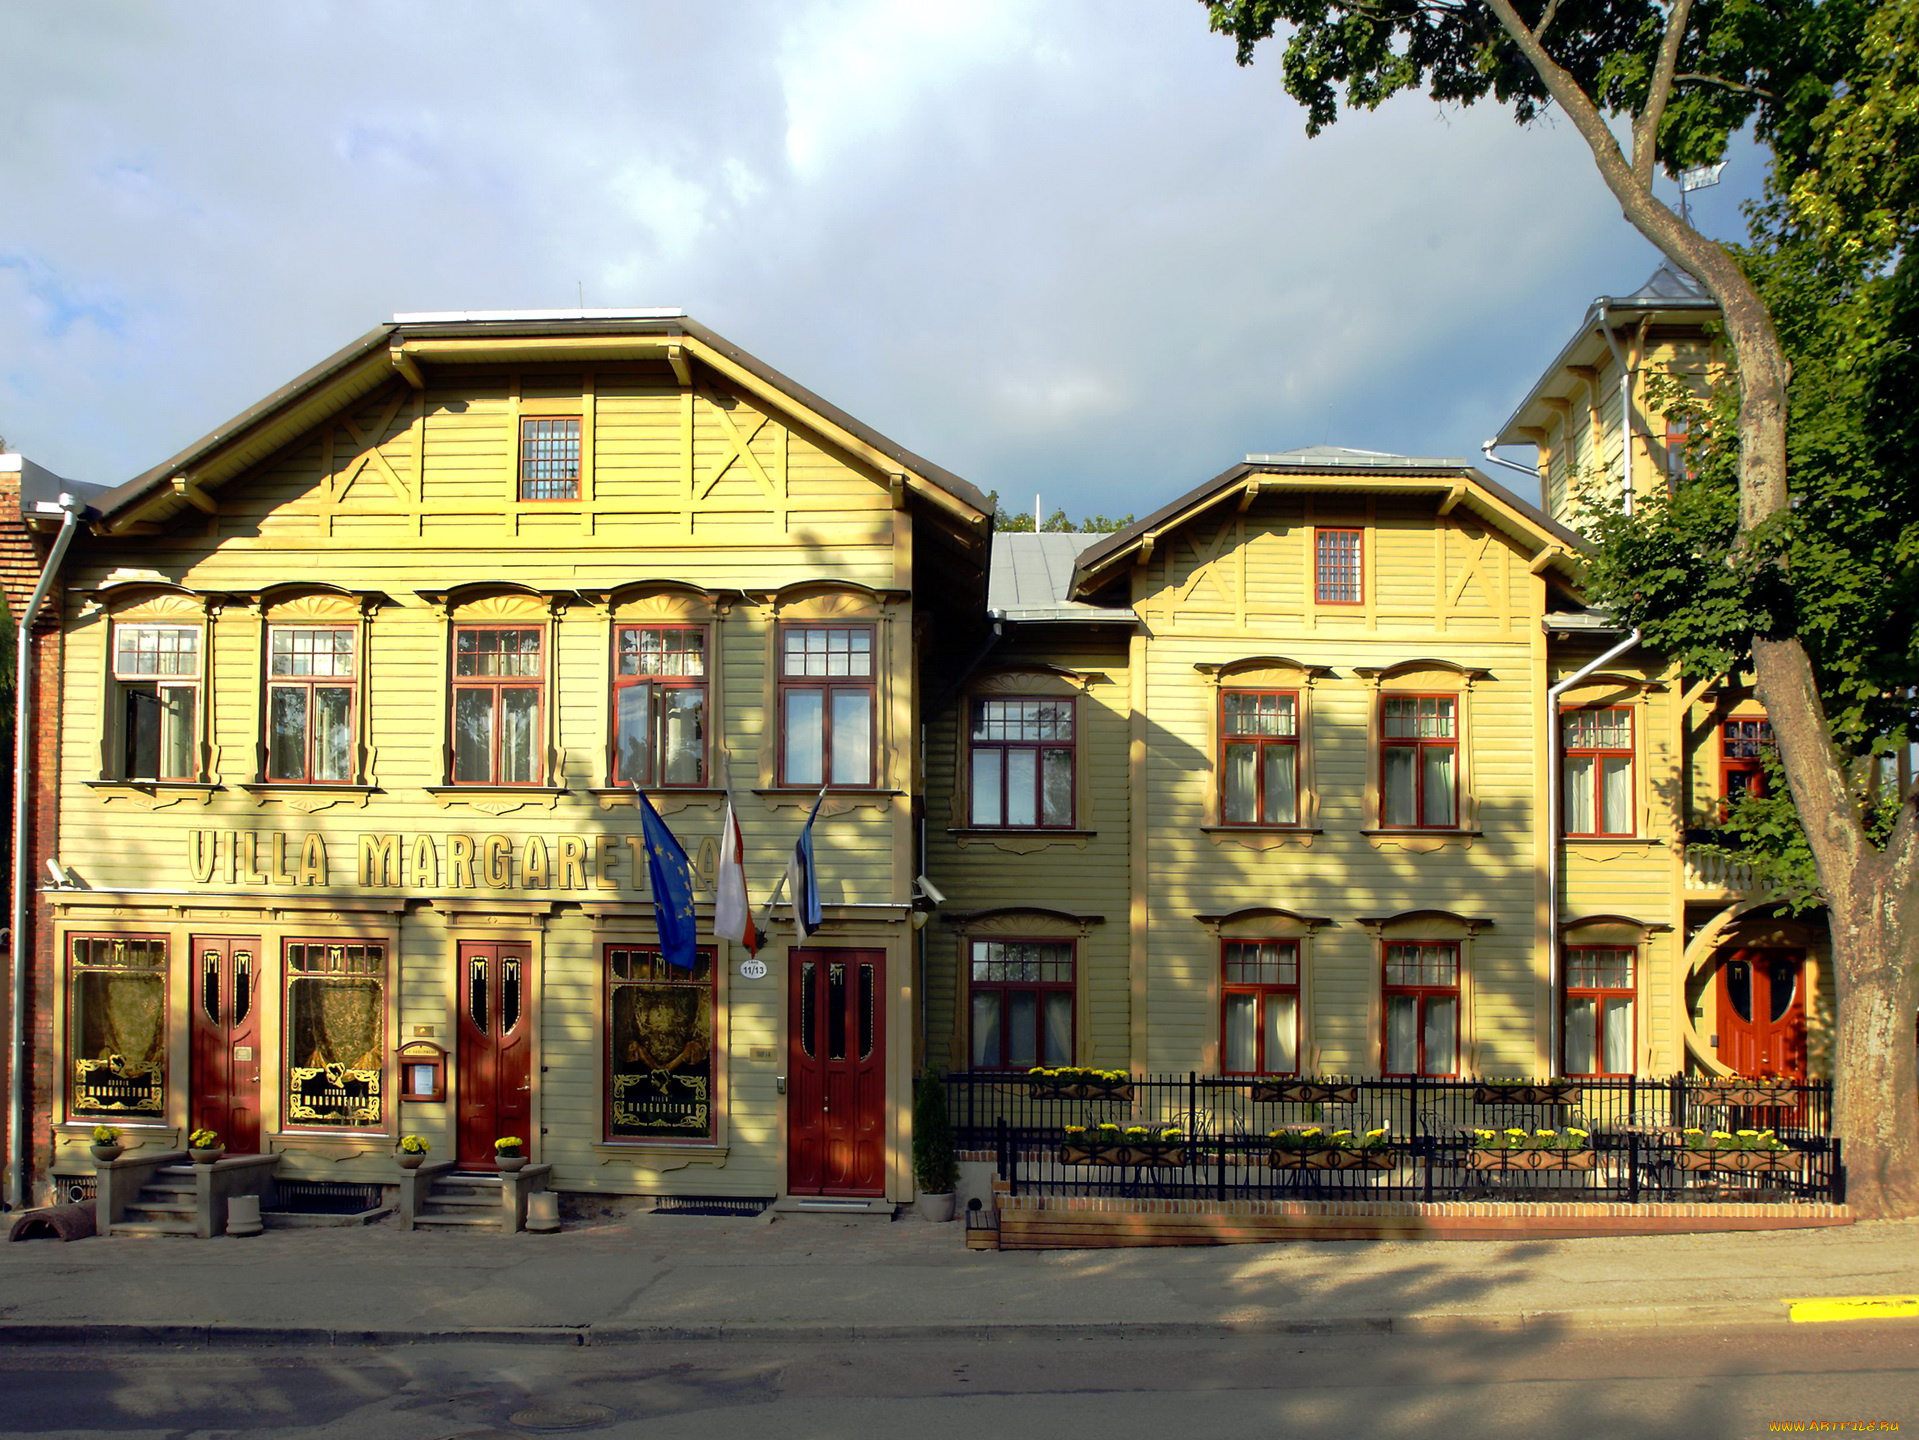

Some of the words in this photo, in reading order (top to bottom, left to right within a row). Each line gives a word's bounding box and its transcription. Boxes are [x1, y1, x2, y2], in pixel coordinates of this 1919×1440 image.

[188, 830, 329, 887] VILLA
[357, 833, 720, 891] MARGARETA
[743, 964, 764, 975] 11/13
